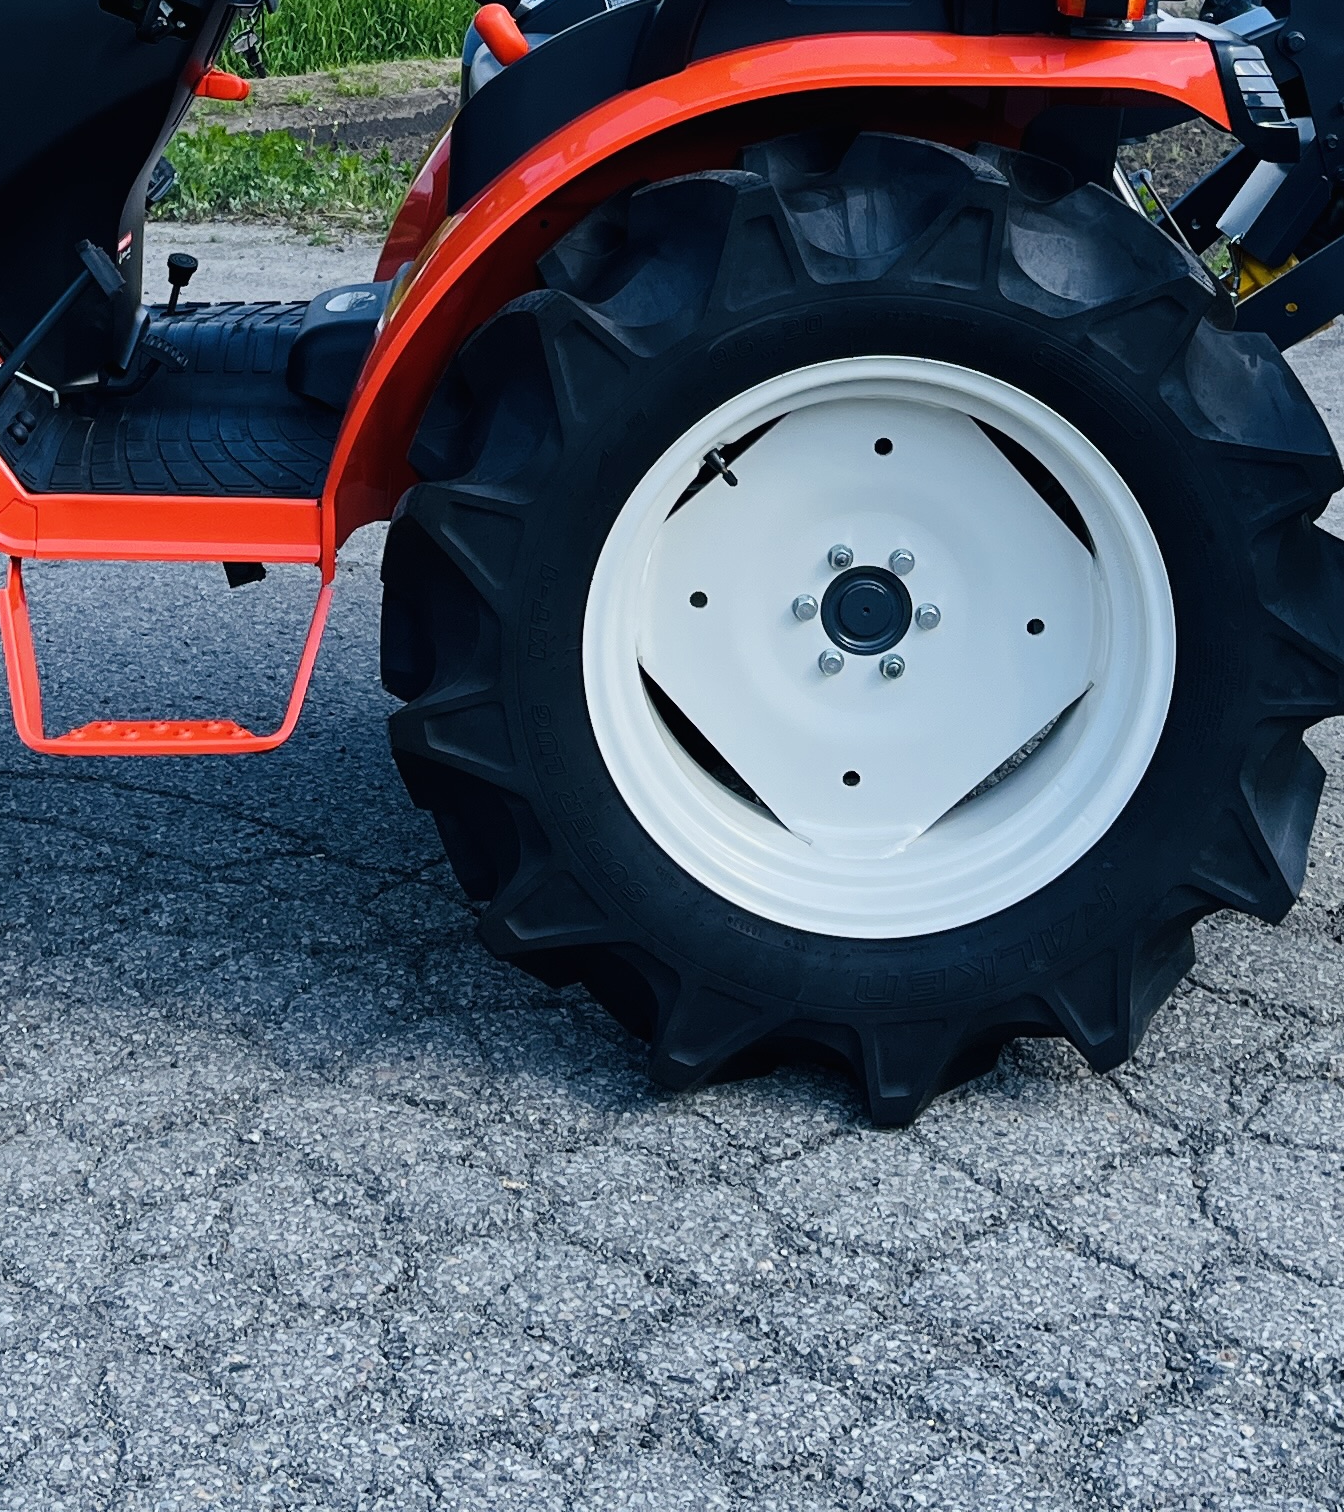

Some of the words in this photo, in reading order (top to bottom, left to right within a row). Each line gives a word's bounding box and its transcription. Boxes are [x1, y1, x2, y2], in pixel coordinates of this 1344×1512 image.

[530, 703, 567, 777] LUG
[556, 791, 648, 904] SUPER
[853, 884, 1117, 1005] FALKEN
